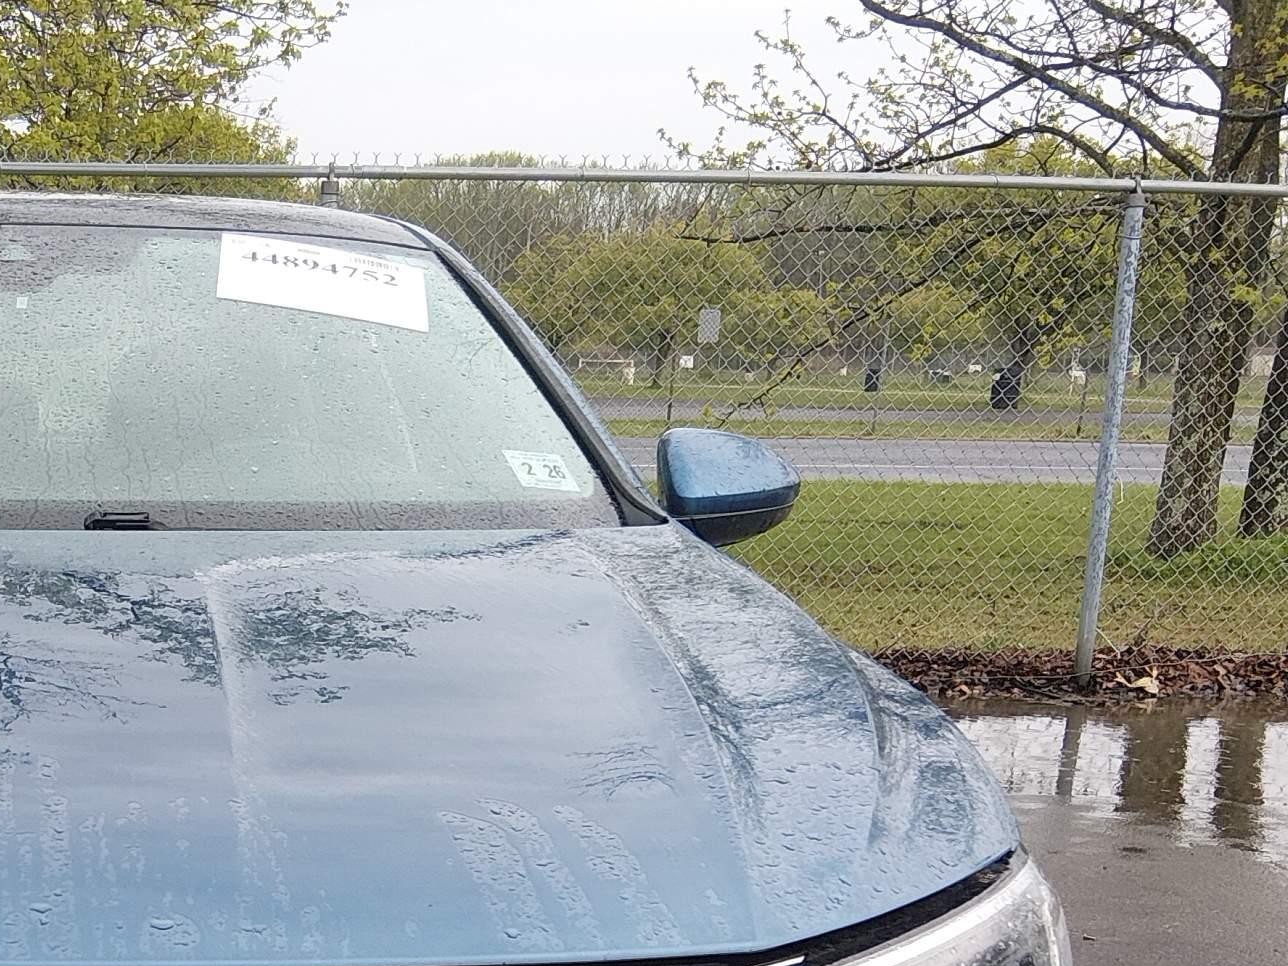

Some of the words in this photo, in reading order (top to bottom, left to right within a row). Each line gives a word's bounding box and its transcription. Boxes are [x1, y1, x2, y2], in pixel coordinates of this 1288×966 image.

[241, 251, 399, 287] 44894752
[521, 462, 537, 476] 2
[543, 464, 566, 479] 26
